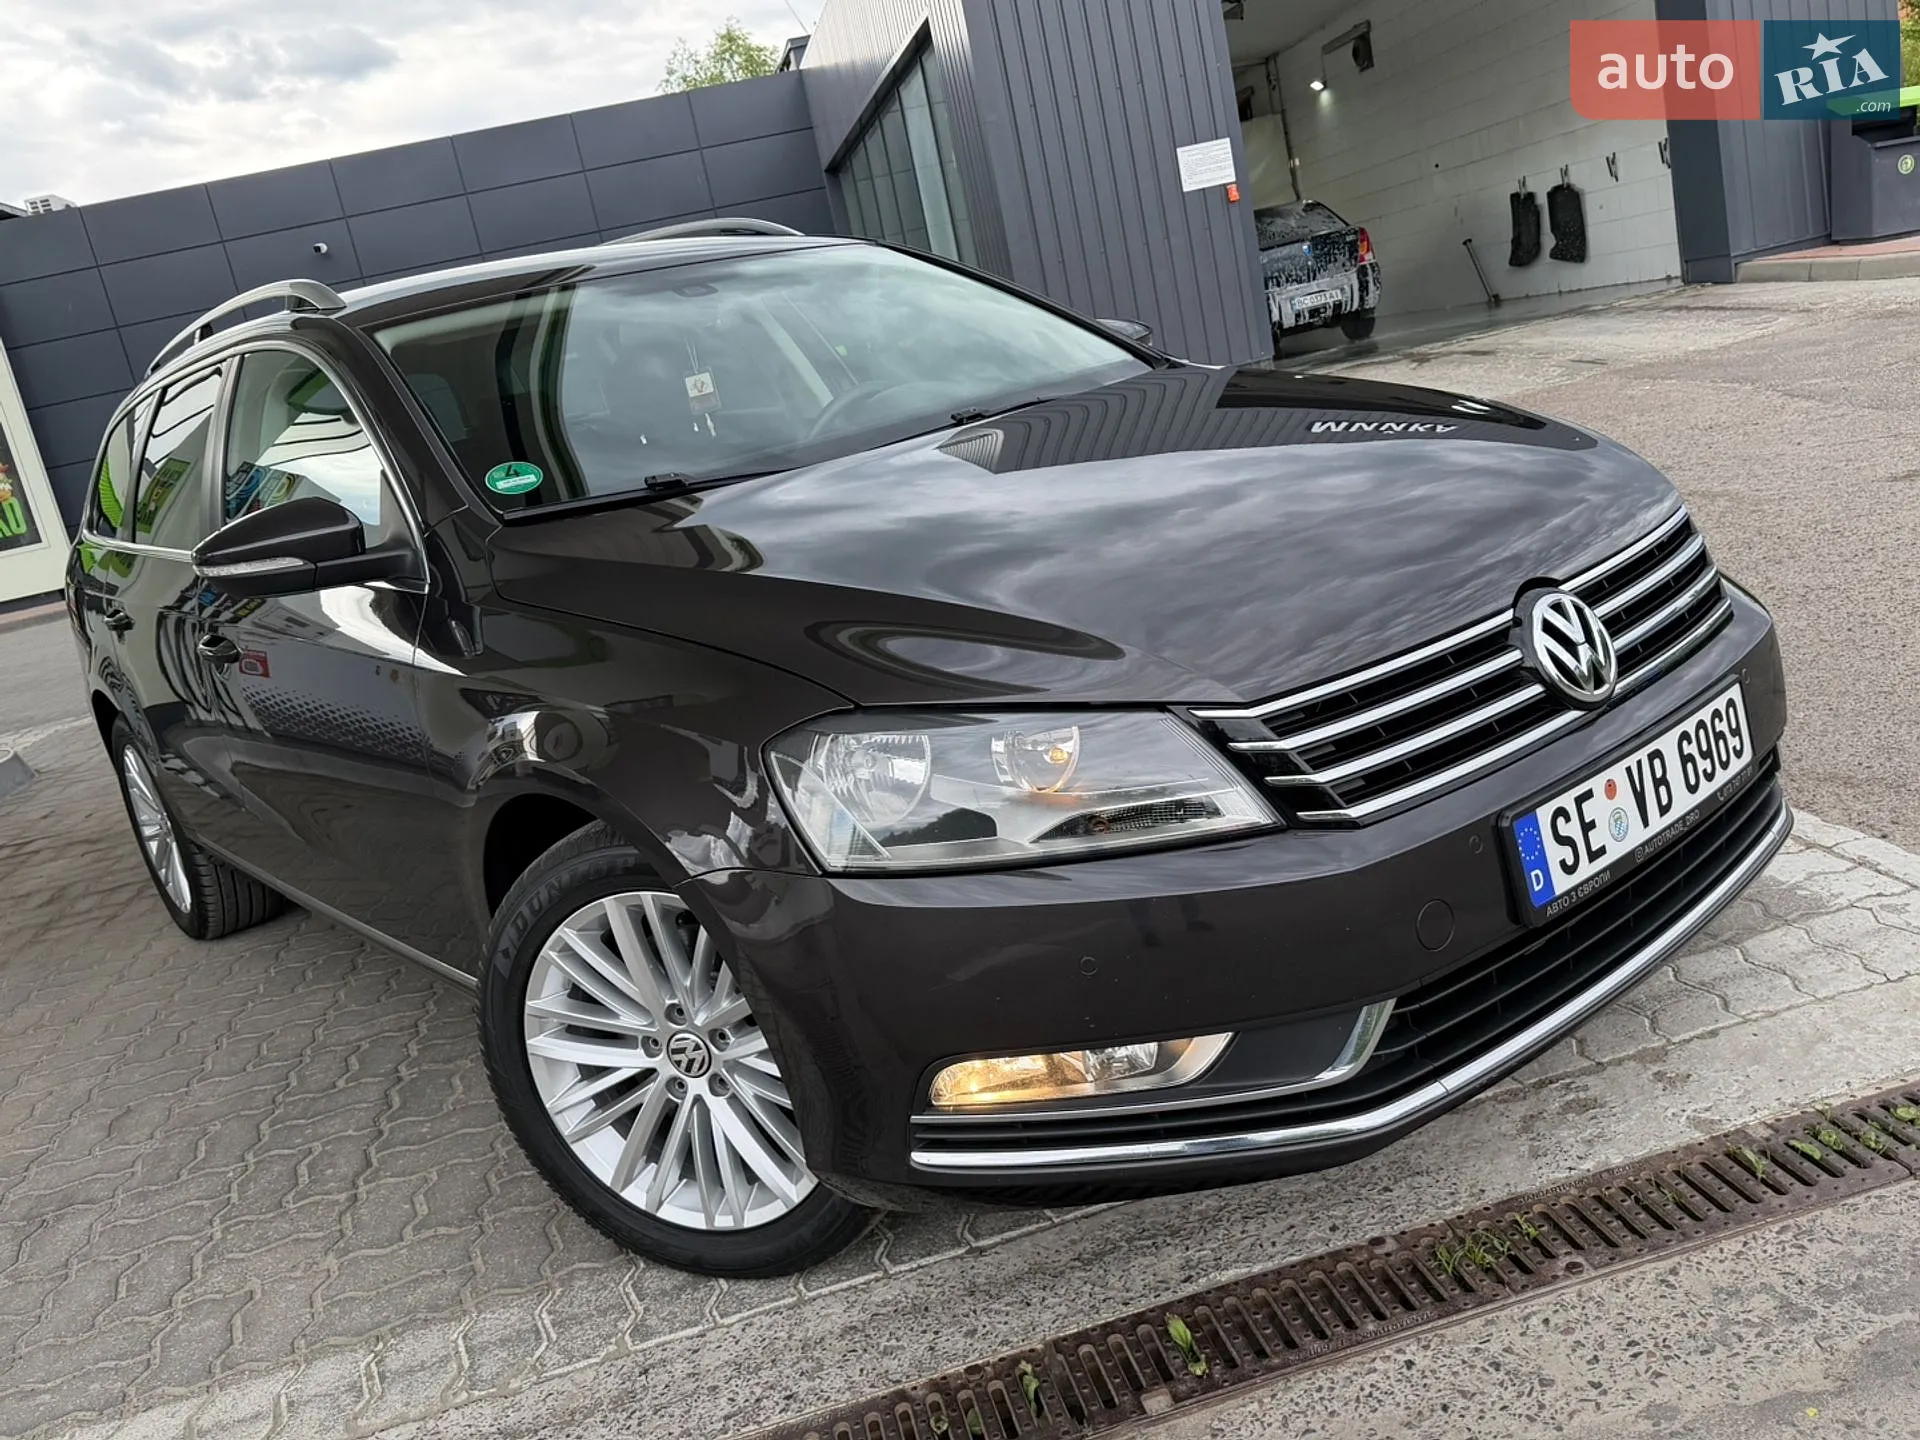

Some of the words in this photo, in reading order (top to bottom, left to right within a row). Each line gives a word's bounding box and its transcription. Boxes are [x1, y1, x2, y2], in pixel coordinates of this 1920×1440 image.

[1550, 788, 1607, 876] SE
[1625, 748, 1673, 830] VB
[1677, 697, 1744, 795] 6969
[1530, 869, 1544, 891] D
